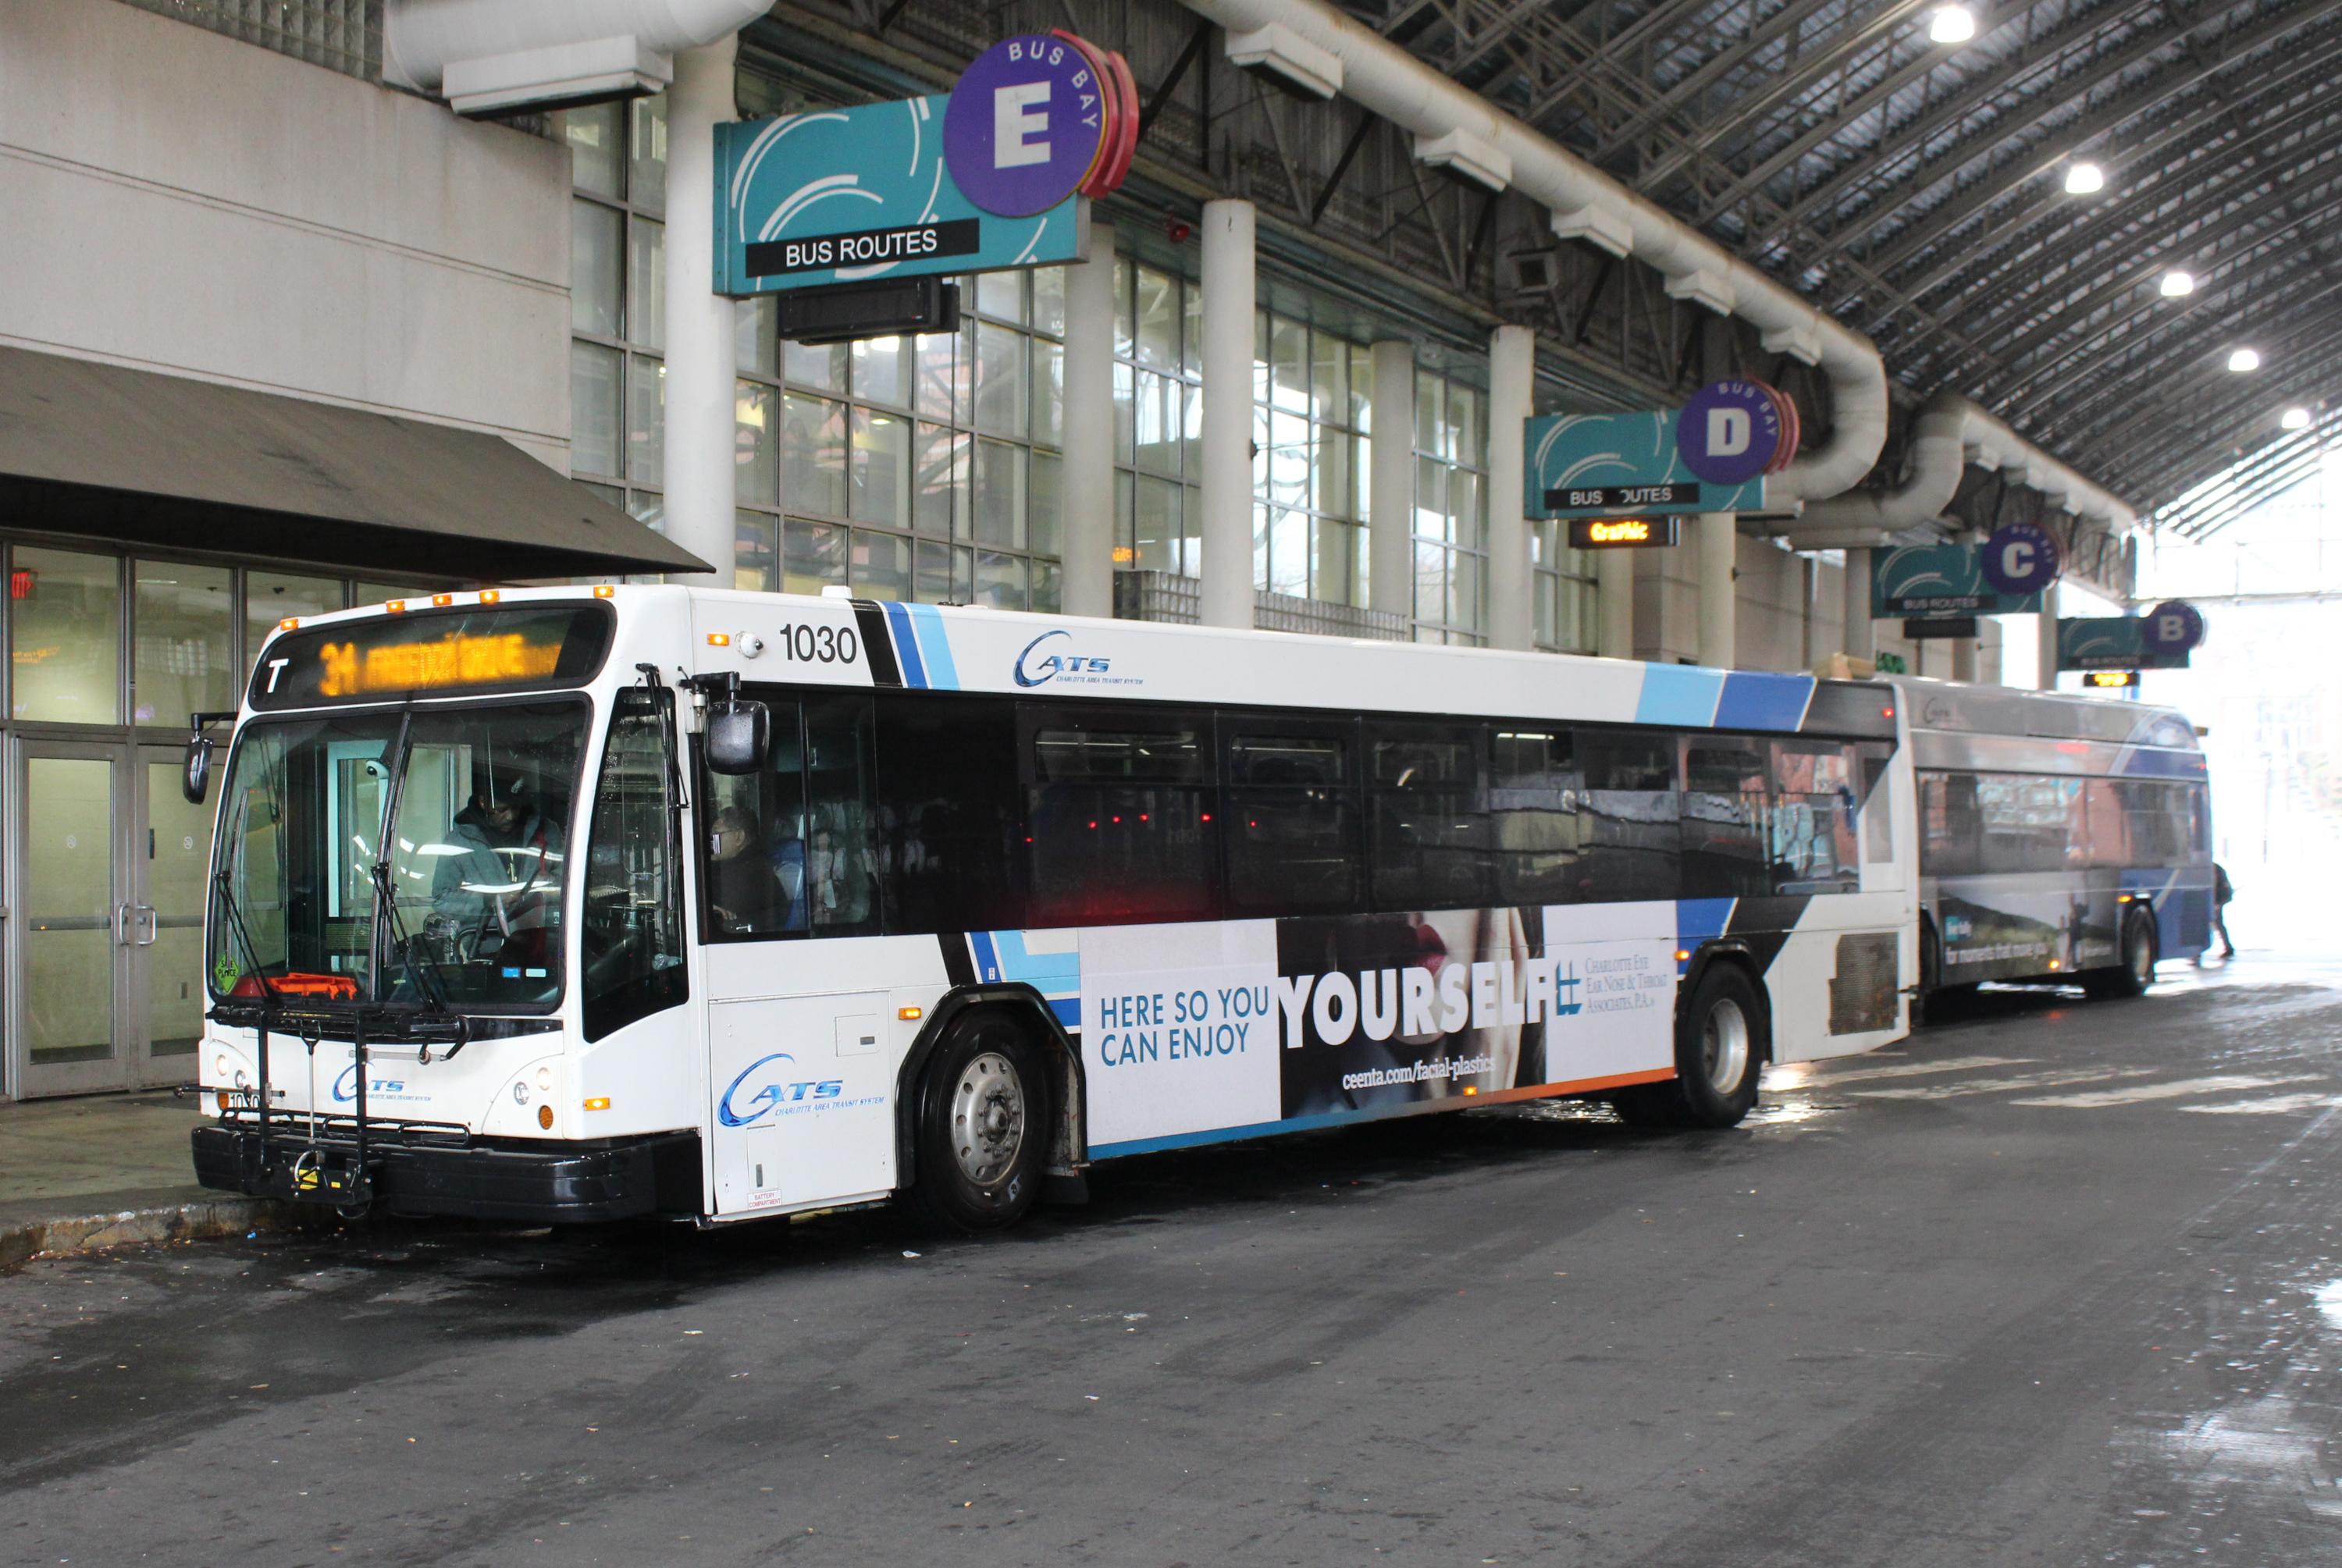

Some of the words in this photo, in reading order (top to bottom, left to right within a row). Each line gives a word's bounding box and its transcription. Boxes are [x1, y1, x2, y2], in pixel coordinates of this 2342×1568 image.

[1009, 41, 1064, 66] BUS
[1072, 69, 1098, 128] BAY
[995, 80, 1051, 169] E
[786, 241, 833, 267] BUS
[840, 229, 937, 261] ROUTES
[1718, 382, 1756, 399] BUS
[1760, 400, 1777, 436] BAY
[1707, 407, 1751, 457] D
[1570, 489, 1603, 506] BUS
[2001, 541, 2035, 578] C
[1902, 598, 1928, 610] BUS
[780, 624, 857, 664] 1030
[2159, 615, 2184, 642] B
[267, 658, 289, 694] T
[1013, 630, 1112, 688] CATS
[1627, 975, 1635, 990] &
[1101, 994, 1163, 1029] HERE
[1174, 990, 1208, 1023] SO
[1218, 986, 1269, 1019] YOU
[1277, 958, 1547, 1049] YOURSELF
[1101, 1031, 1158, 1067] CAN
[1169, 1022, 1249, 1060] ENJOY
[332, 1061, 404, 1102] CTS
[717, 1053, 843, 1127] CATS
[1343, 1054, 1495, 1090] ceenta.com/facial-plastics
[230, 1093, 260, 1108] 100
[775, 1105, 812, 1116] CHARLOTTE
[813, 1102, 830, 1111] AREA
[831, 1099, 858, 1109] TRANSIT
[859, 1096, 884, 1106] SYSTEM
[749, 1198, 781, 1207] COMPARTMENT
